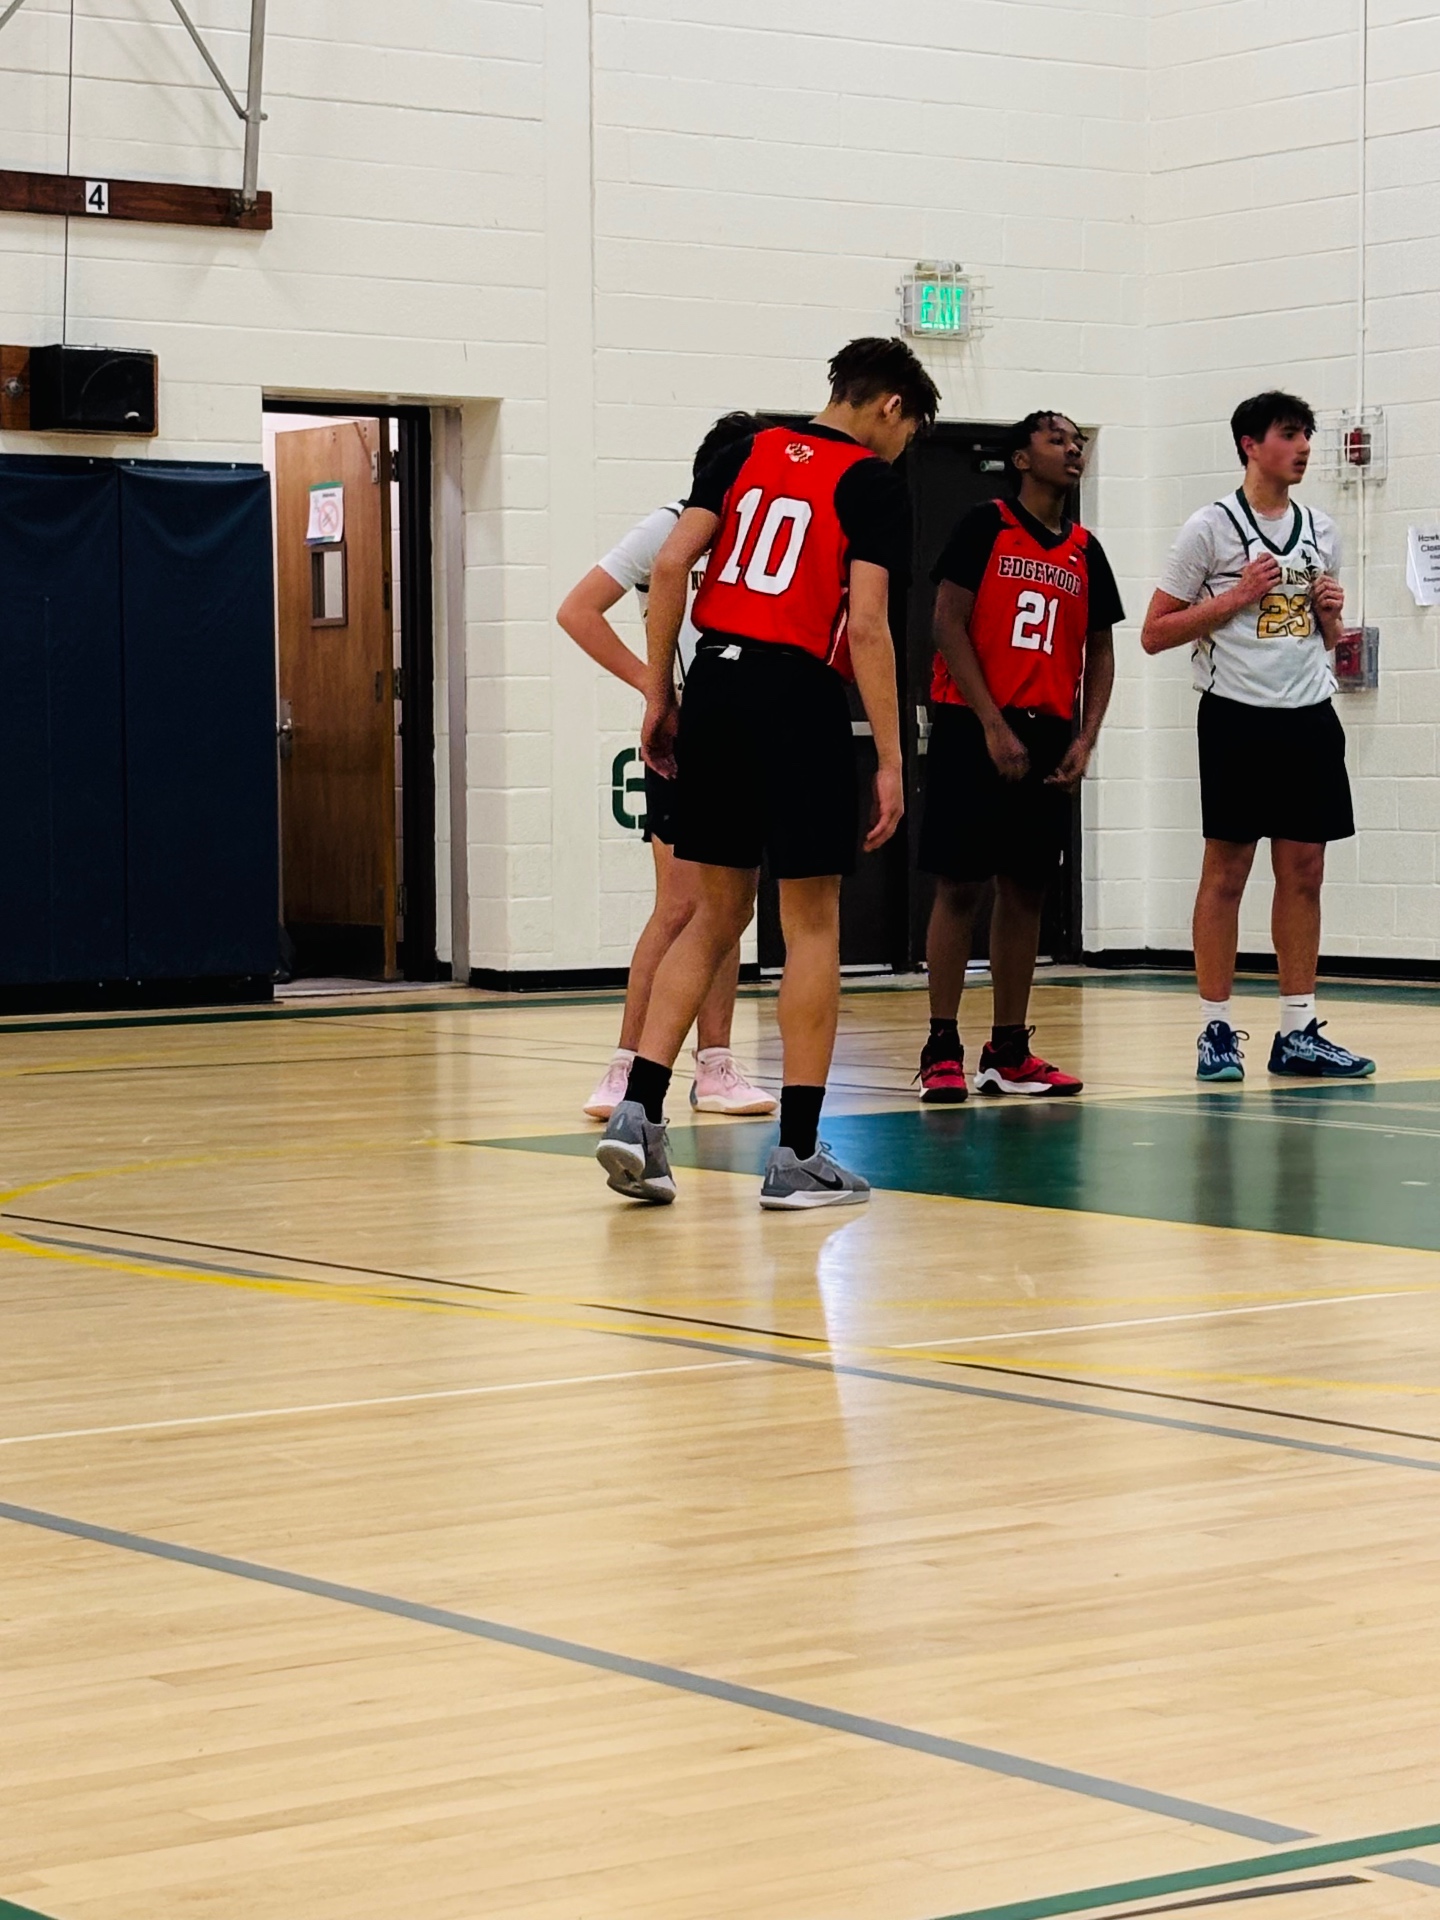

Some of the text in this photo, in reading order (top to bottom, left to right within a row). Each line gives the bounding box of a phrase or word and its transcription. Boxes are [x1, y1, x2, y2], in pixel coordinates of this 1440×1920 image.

[88, 184, 105, 211] 4
[716, 486, 813, 596] 10
[998, 555, 1081, 597] EDGEWOOD
[1011, 590, 1059, 656] 21
